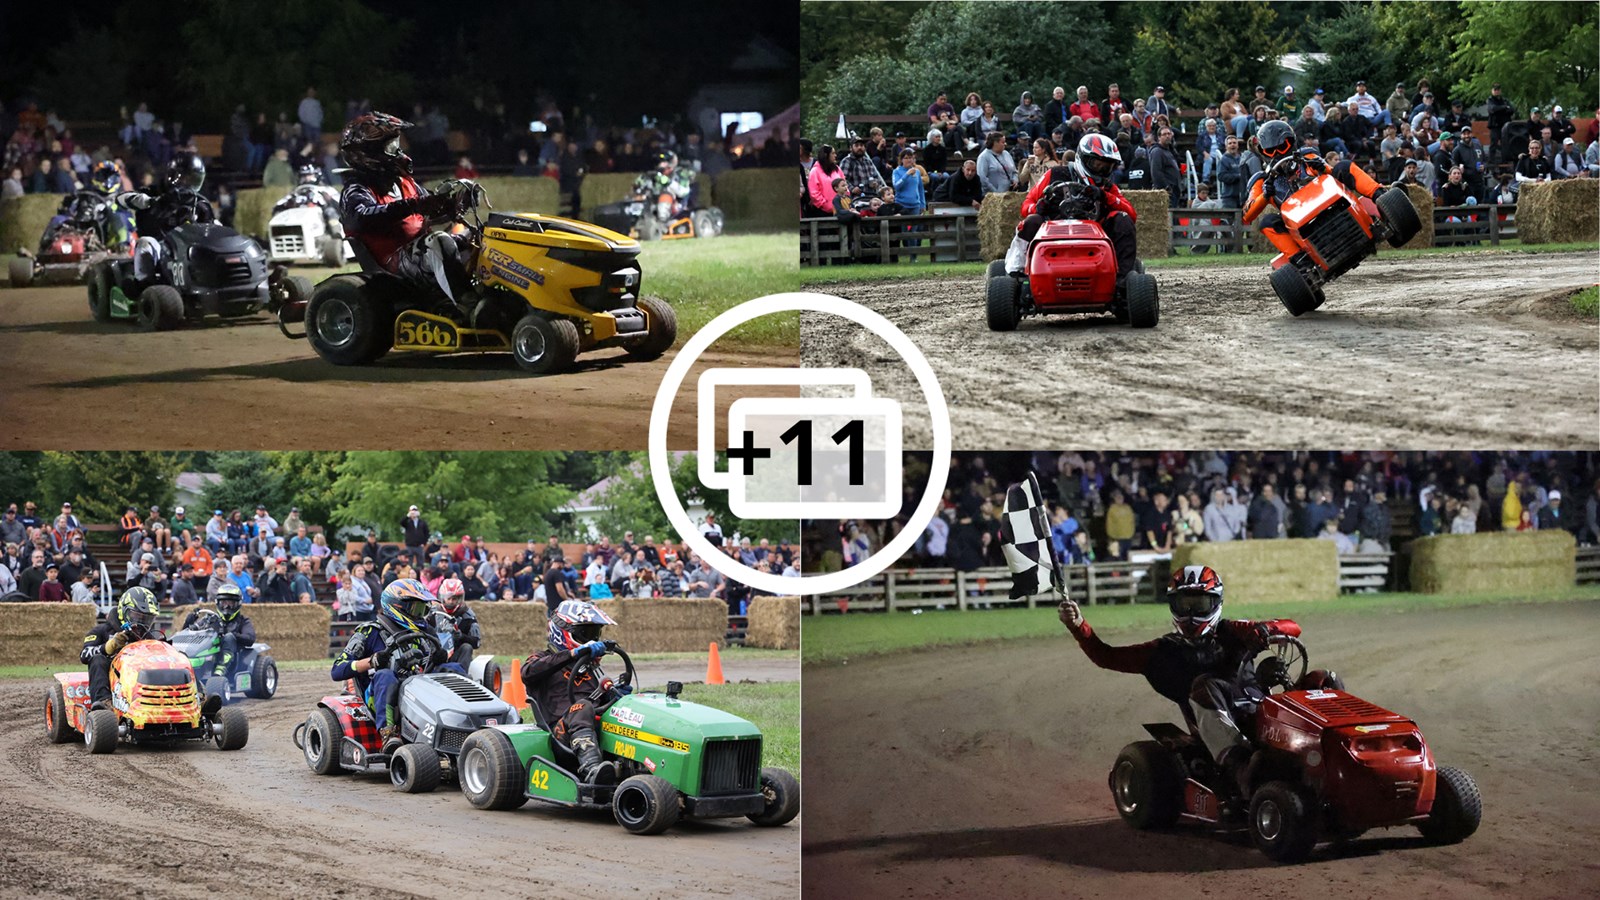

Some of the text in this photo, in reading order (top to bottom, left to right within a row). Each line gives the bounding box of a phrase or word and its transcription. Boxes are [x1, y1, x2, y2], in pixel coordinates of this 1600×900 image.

[488, 249, 545, 284] RR SMALL
[492, 266, 529, 288] ENGINE
[400, 322, 451, 346] 566
[610, 707, 643, 724] MARLEAU
[422, 723, 435, 739] 22
[602, 723, 617, 732] JOHN
[618, 726, 639, 739] DEERE
[531, 769, 549, 790] 42
